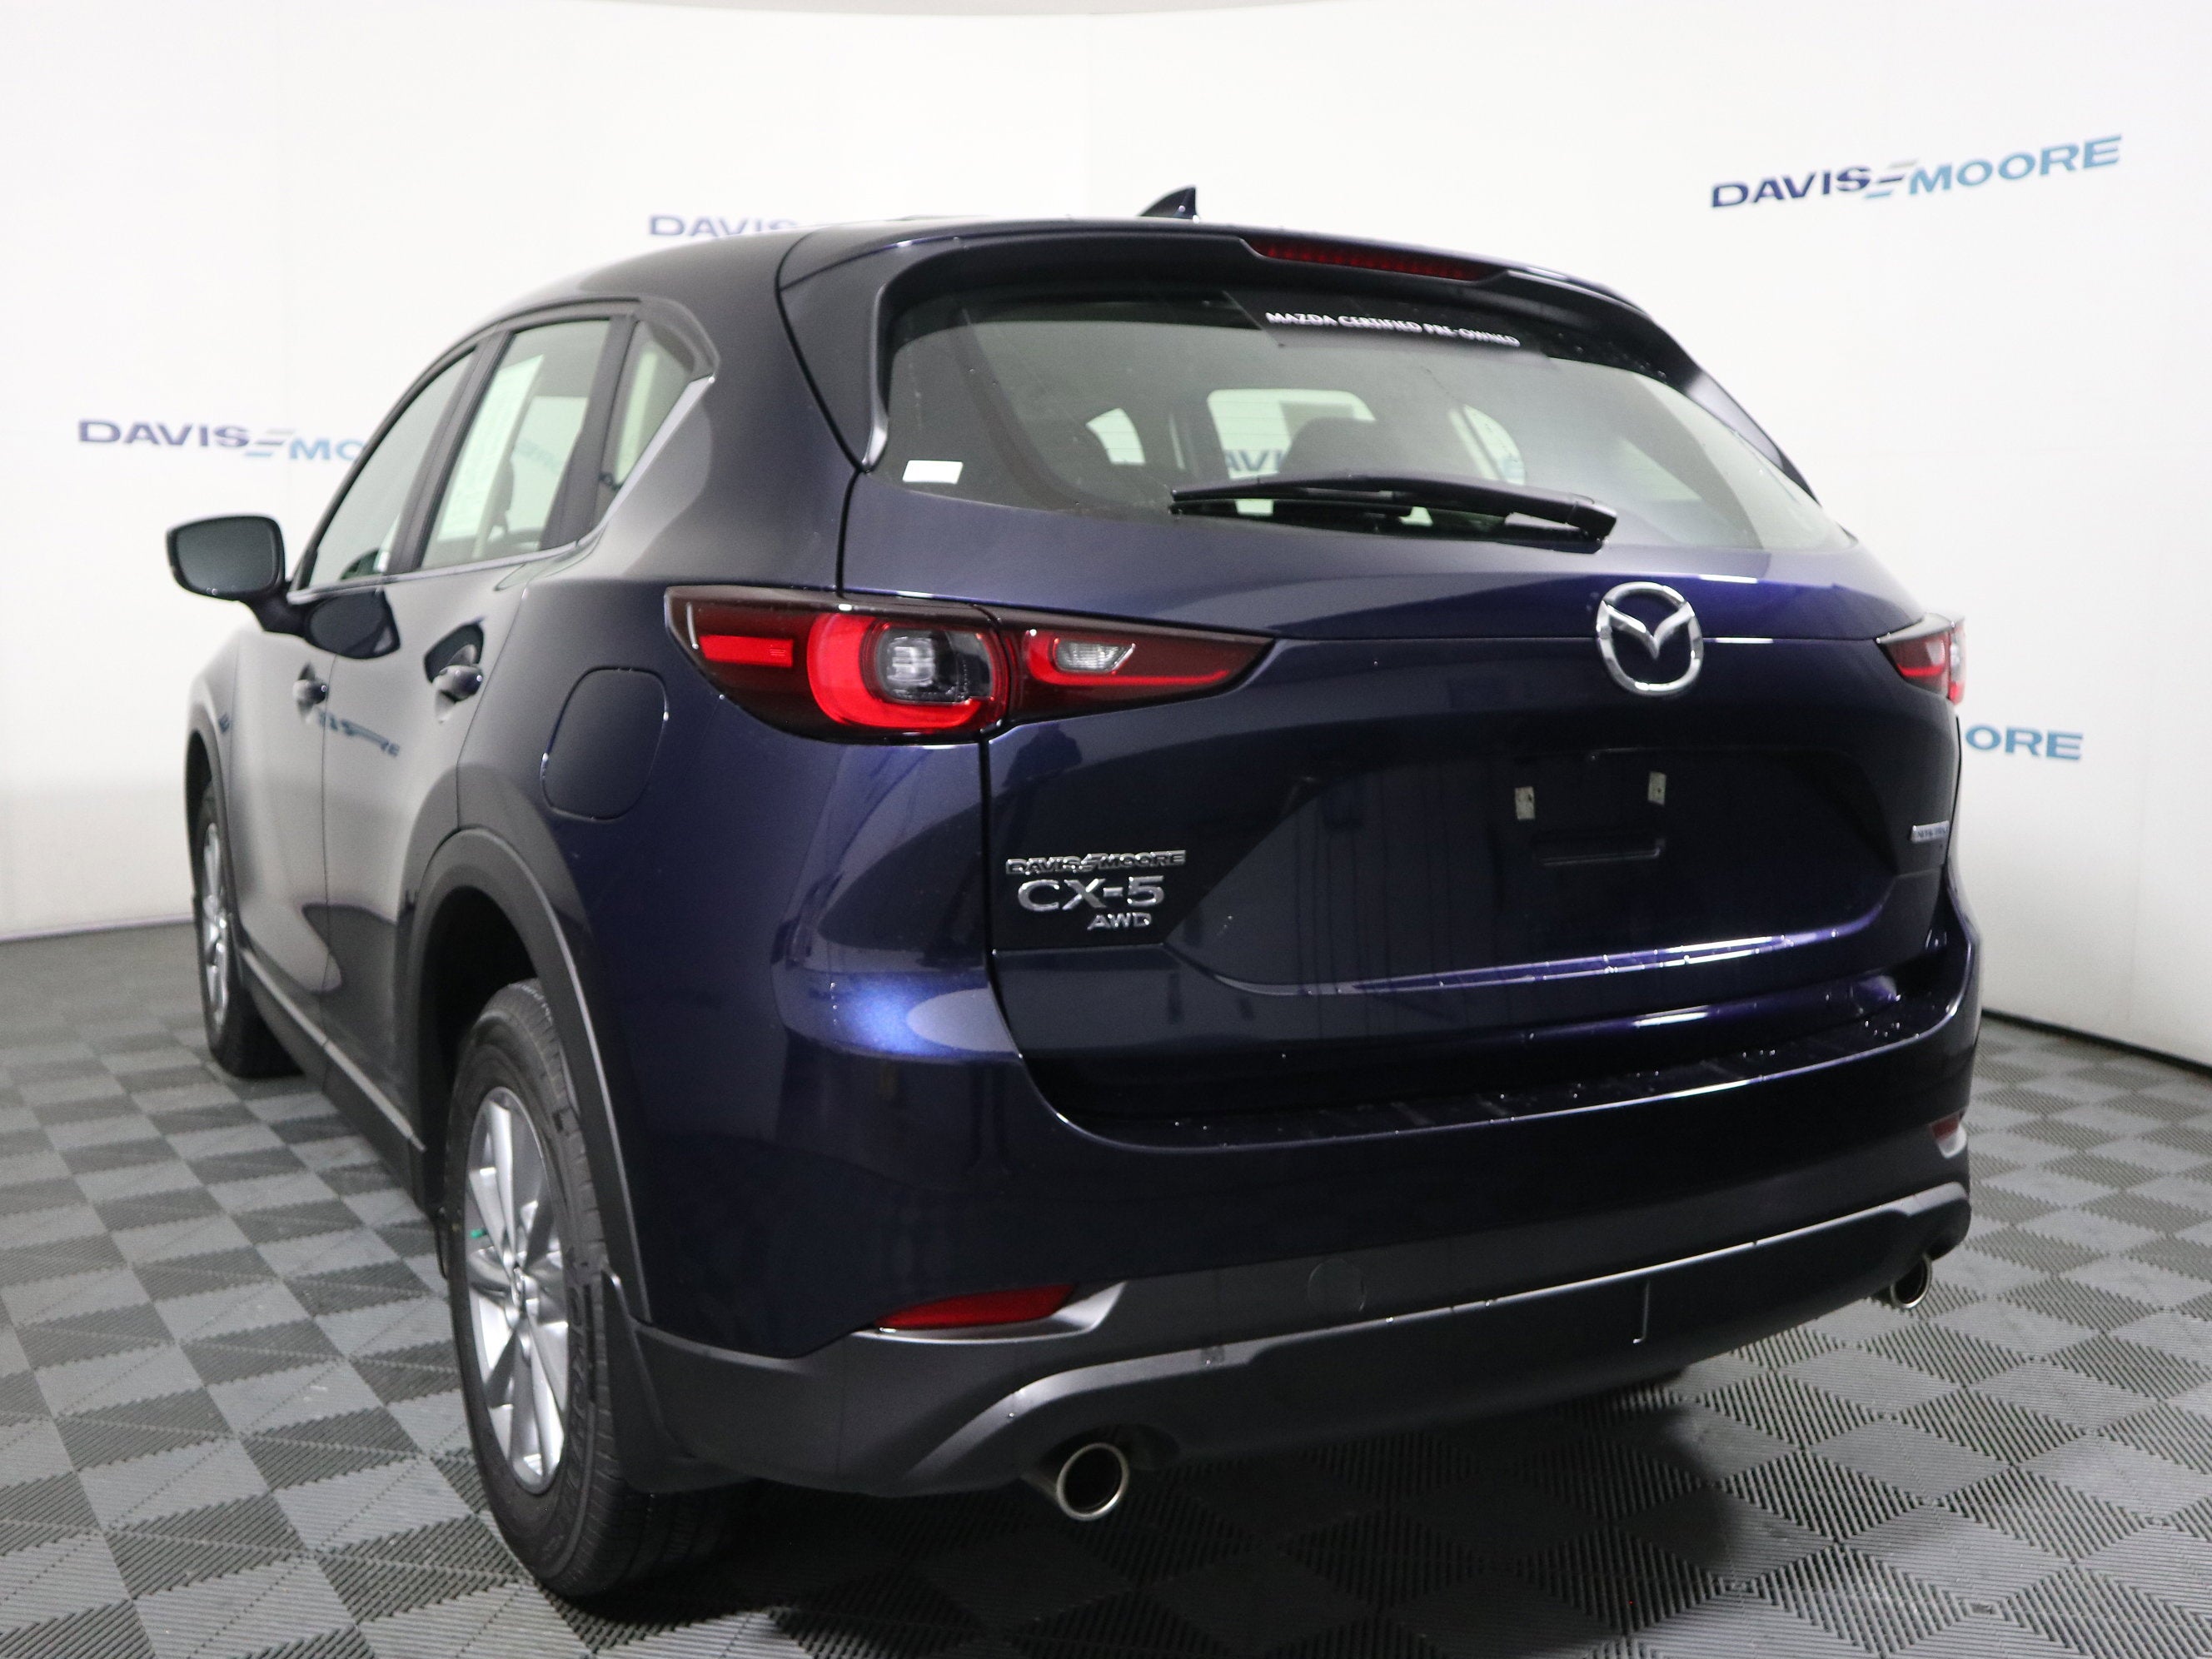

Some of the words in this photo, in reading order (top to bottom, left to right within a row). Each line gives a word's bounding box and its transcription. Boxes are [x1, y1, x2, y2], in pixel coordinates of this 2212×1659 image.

[1711, 168, 1871, 208] DAVIS
[1909, 133, 2122, 196] MOORE
[1265, 311, 1338, 327] MAZDA
[1338, 315, 1423, 333] CERTIFIED
[1422, 322, 1522, 348] PRE-OWNED
[78, 419, 249, 447] DAVIS
[1965, 724, 2084, 761] ORE
[1018, 874, 1165, 913] CX-5
[1086, 911, 1153, 931] AWD
